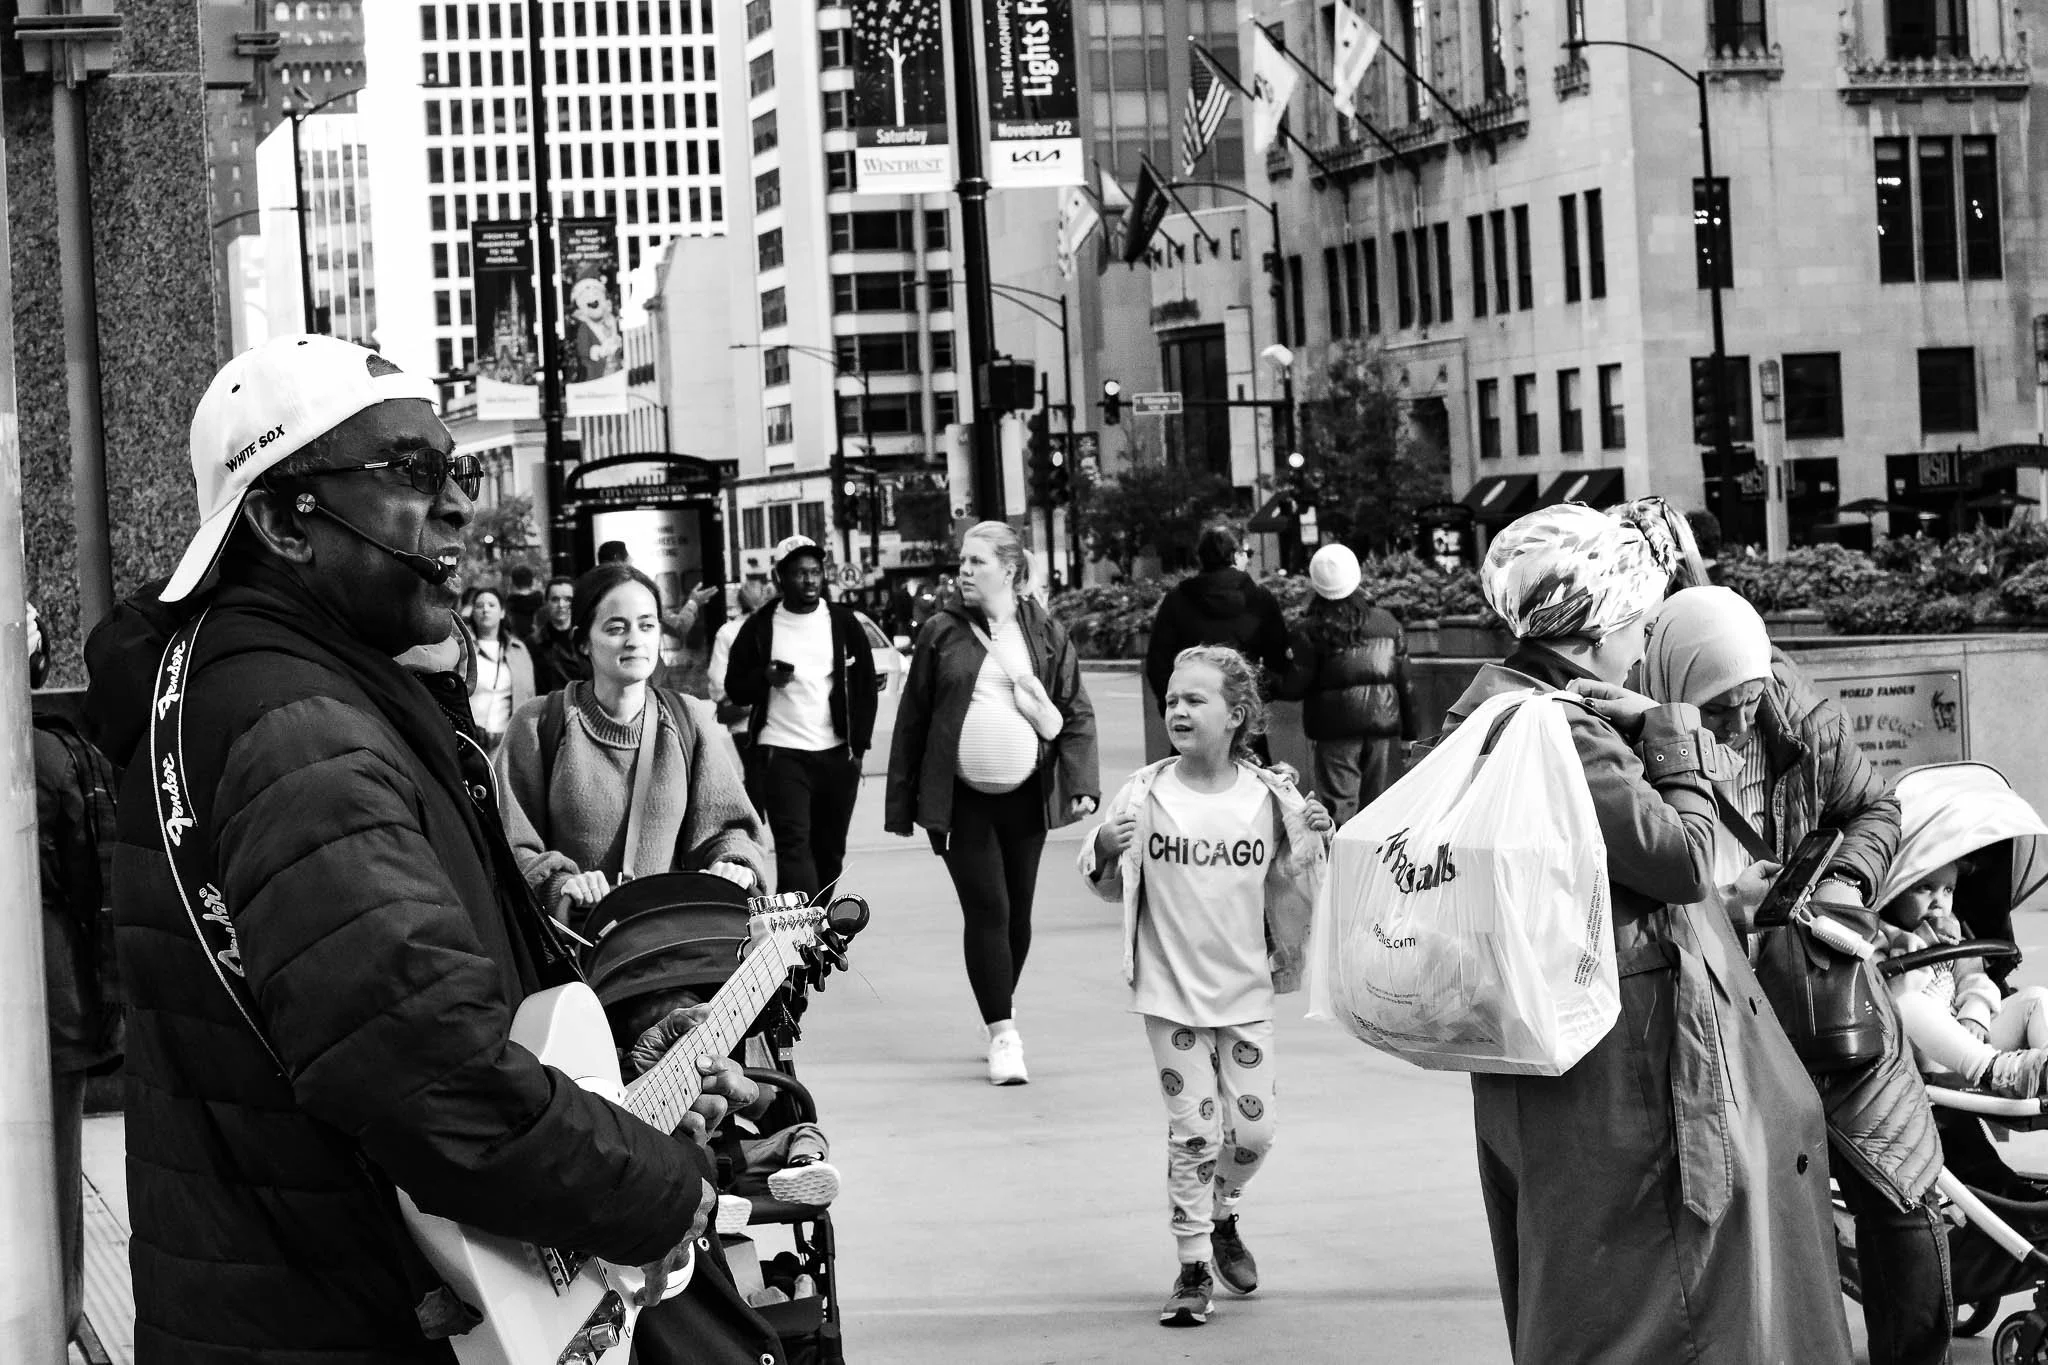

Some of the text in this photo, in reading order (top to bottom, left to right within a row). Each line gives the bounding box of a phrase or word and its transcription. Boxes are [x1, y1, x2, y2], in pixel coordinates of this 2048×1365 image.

[1016, 0, 1059, 96] Lights F
[1001, 70, 1015, 98] THE
[876, 128, 928, 145] Saturday
[997, 120, 1072, 138] November 22
[1011, 150, 1060, 162] KIA
[225, 424, 286, 473] WHITE SOX
[623, 484, 687, 497] INFORMATION
[157, 640, 186, 721] Fender
[1840, 685, 1916, 698] WORLD FAMOUS
[162, 753, 193, 847] Fender
[1149, 832, 1264, 867] CHICAGO
